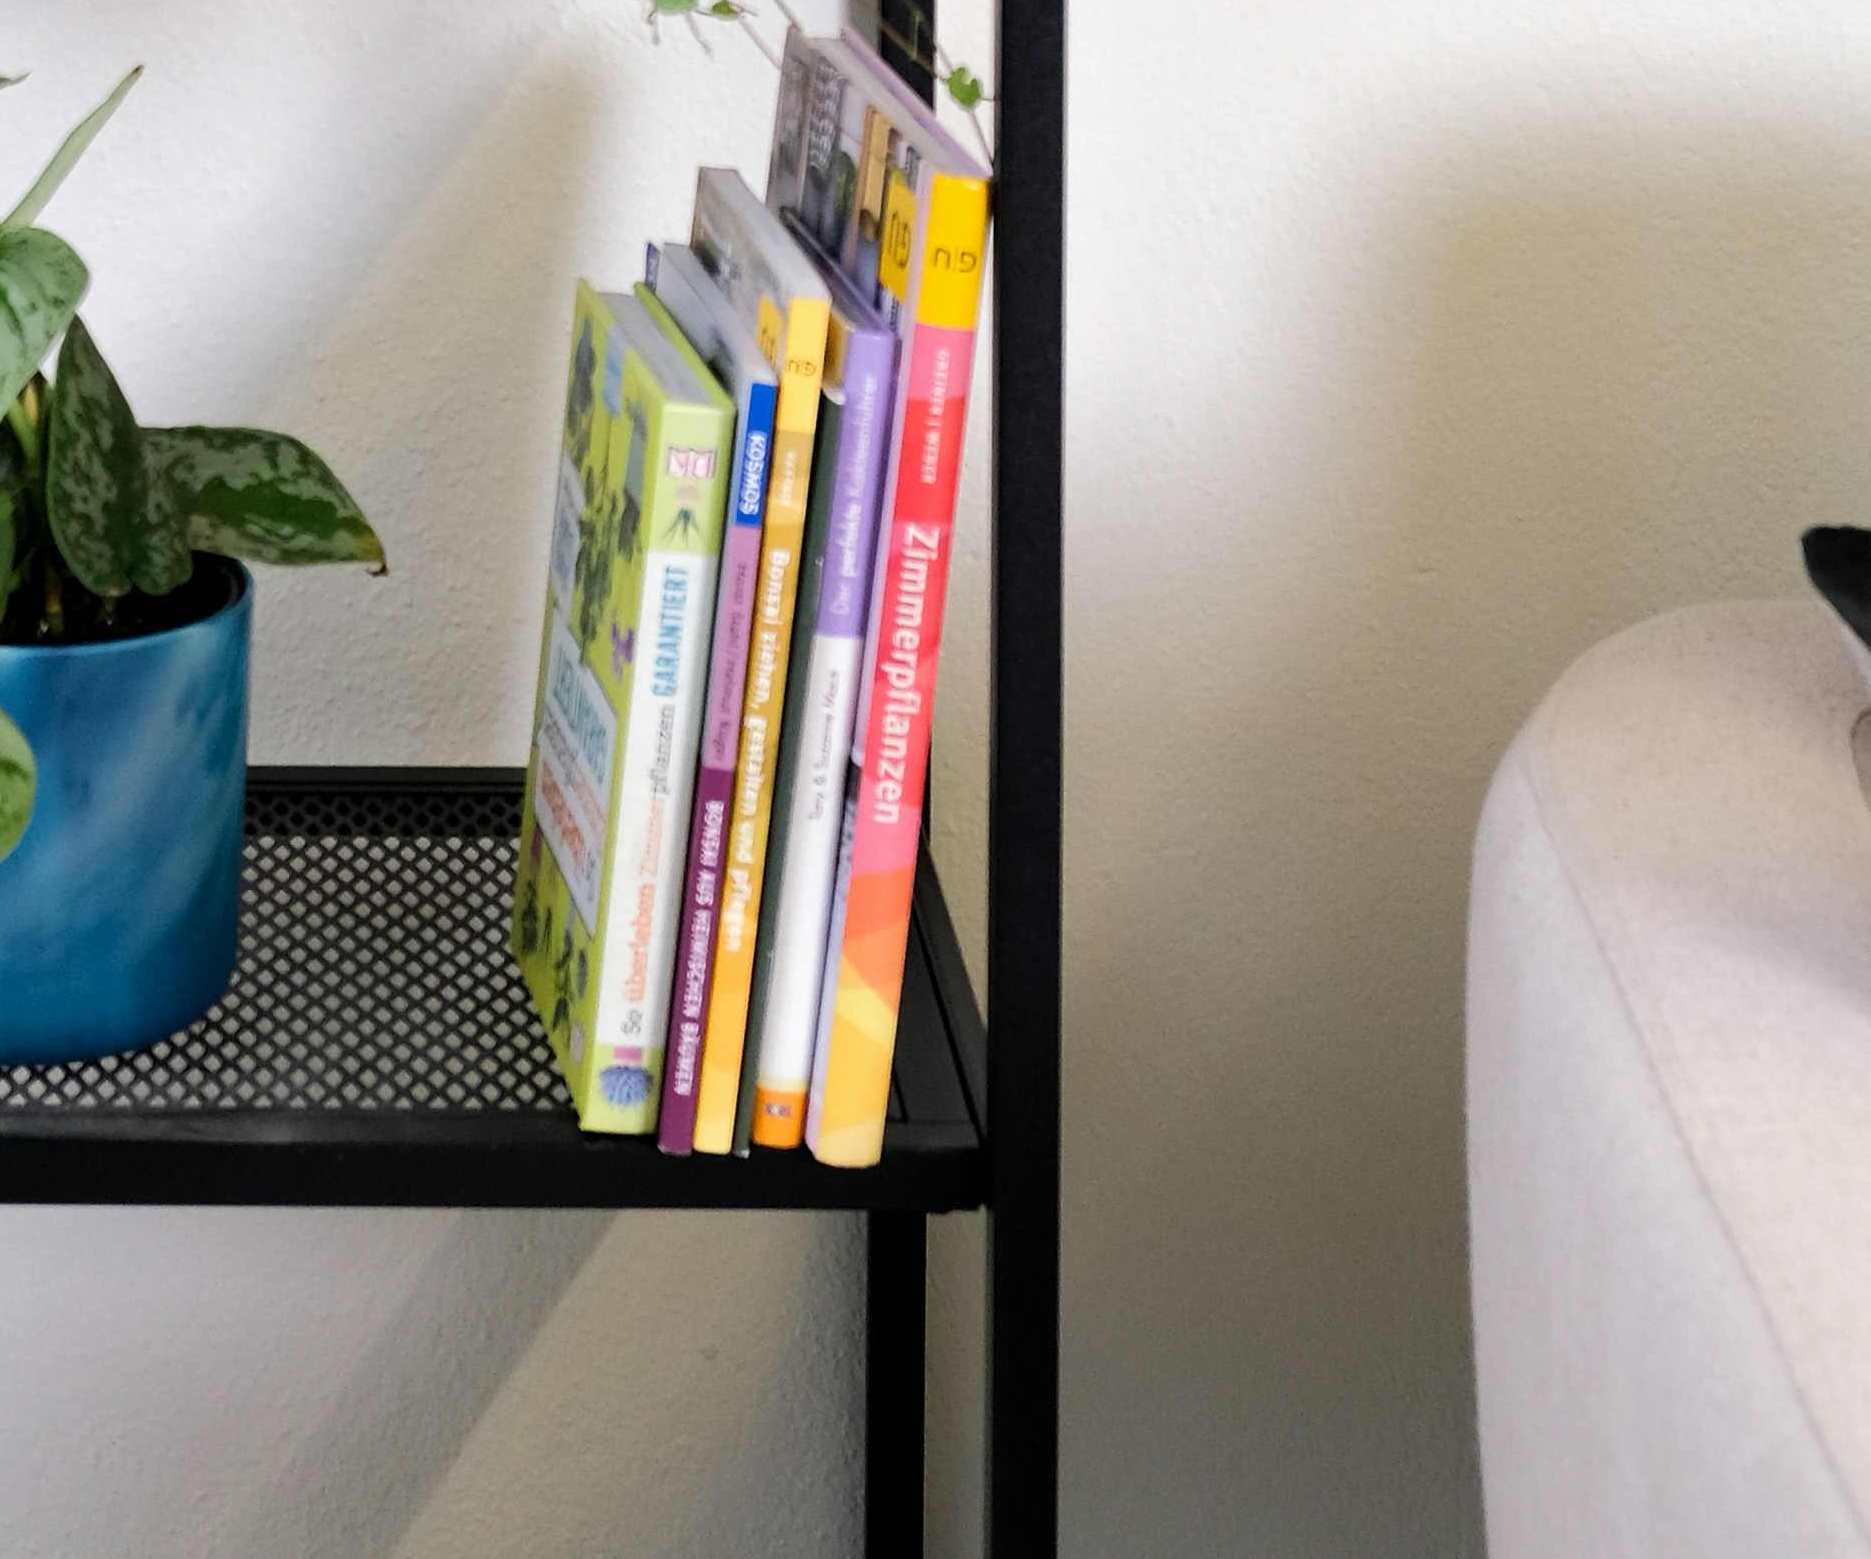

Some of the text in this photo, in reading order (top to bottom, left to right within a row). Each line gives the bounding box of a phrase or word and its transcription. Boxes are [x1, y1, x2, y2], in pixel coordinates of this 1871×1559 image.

[739, 429, 768, 516] KOSMOS
[837, 503, 864, 576] perfekte
[764, 548, 790, 626] Bonsai
[873, 524, 939, 825] Zimmerpflanzen
[623, 882, 655, 1003] überleben
[652, 565, 690, 698] GARANTIERT
[737, 714, 768, 817] gestalten
[698, 799, 725, 867] BONSAI
[735, 820, 757, 863] und
[695, 869, 717, 905] AUS
[722, 868, 753, 951] pflegen
